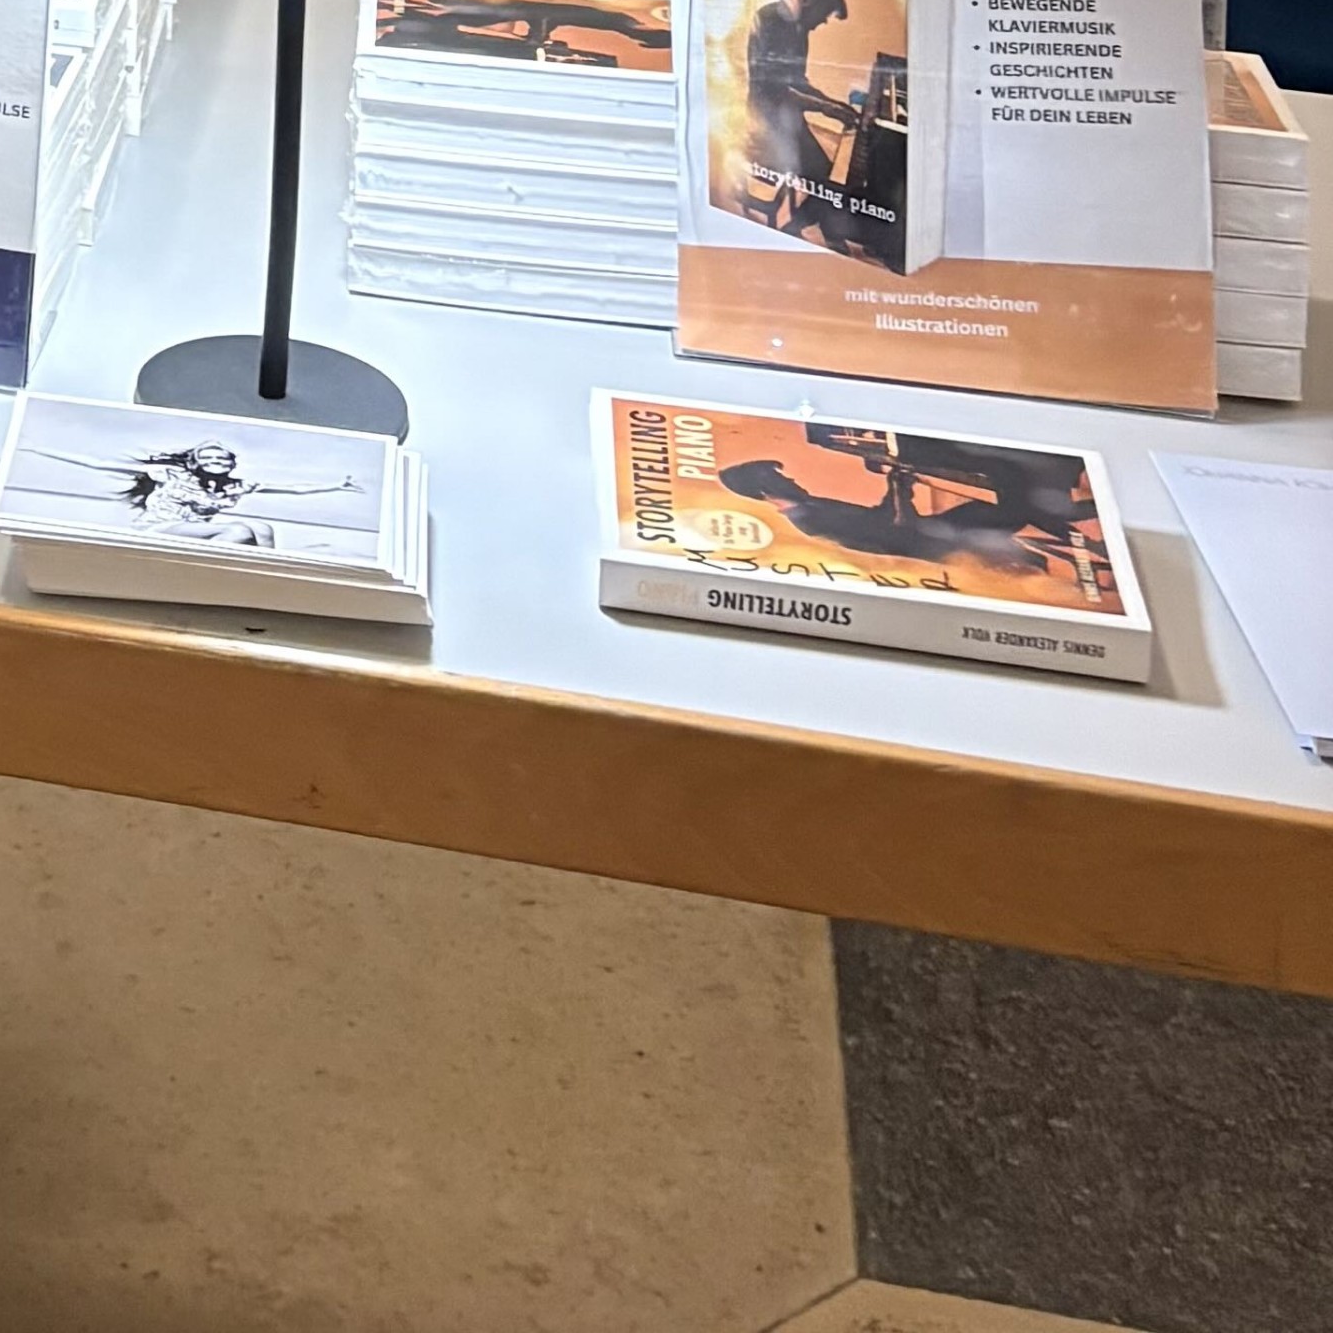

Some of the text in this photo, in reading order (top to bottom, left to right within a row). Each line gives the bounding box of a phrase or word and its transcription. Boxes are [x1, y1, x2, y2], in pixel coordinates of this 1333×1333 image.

[988, 19, 1116, 37] KLAVIERMUSIK
[989, 41, 1122, 59] INSPIRIERENDE
[989, 64, 1114, 80] GESCHICHTEN
[990, 85, 1177, 105] WERTVOLLE IMPULSE
[991, 105, 1133, 126] FÜR DEIN LEBEN
[850, 197, 896, 223] piano
[845, 287, 1039, 314] mit wunderschönen
[875, 314, 1009, 338] Illustrationen
[673, 414, 717, 482] PIANO
[629, 410, 676, 543] STORYTELLING
[708, 589, 852, 626] STORYTELLING
[962, 626, 1105, 658] DENNIS ALEXANDER VOLK
